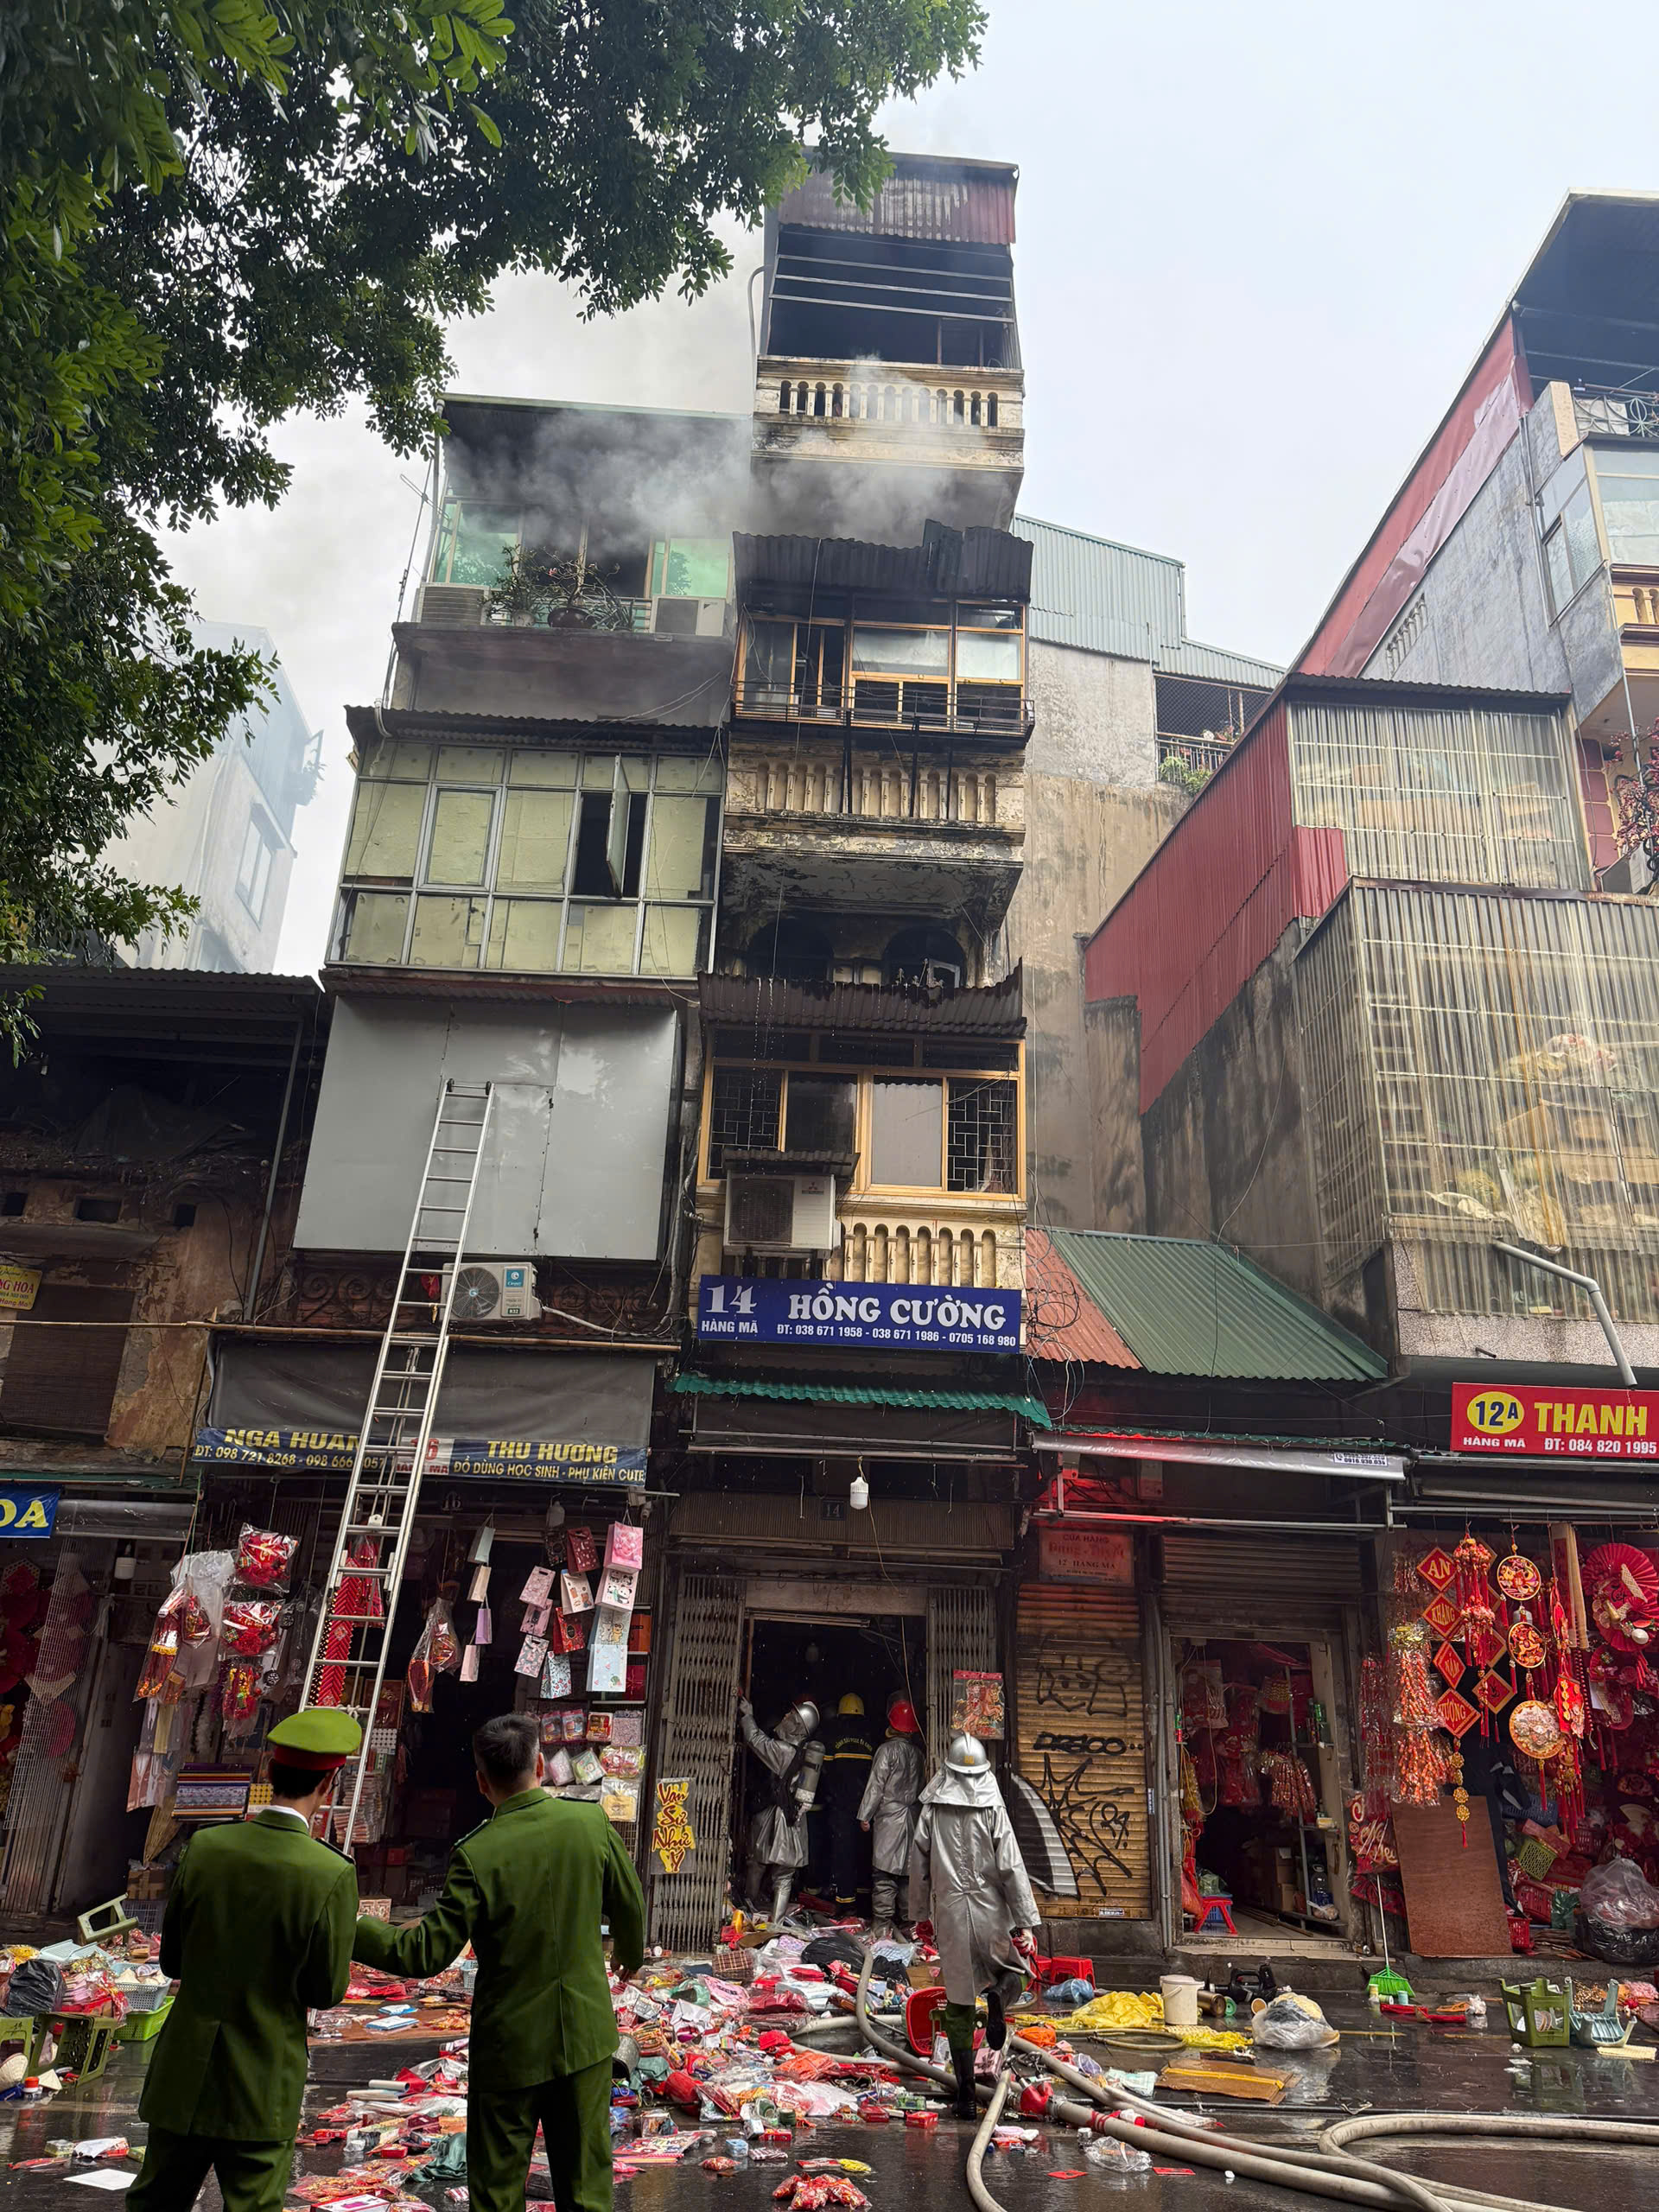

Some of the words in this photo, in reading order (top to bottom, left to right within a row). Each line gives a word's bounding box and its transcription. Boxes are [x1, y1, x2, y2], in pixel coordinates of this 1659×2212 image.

[13, 1281, 35, 1294] HOA
[705, 1285, 757, 1314] 14
[788, 1282, 881, 1323] HỒNG
[890, 1294, 1007, 1331] CƯỜNG
[702, 1319, 734, 1333] HÀNG
[739, 1320, 758, 1333] MÃ
[777, 1325, 792, 1335] ĐT:
[795, 1325, 814, 1336] 038
[817, 1325, 834, 1337] 671
[838, 1326, 862, 1338] 1958
[873, 1328, 891, 1339] 038
[893, 1330, 911, 1340] 671
[915, 1331, 939, 1342] 1986
[950, 1332, 974, 1344] 0705
[976, 1334, 995, 1345] 168
[997, 1336, 1016, 1347] 980
[1475, 1401, 1519, 1427] 12A
[1534, 1402, 1649, 1436] THANH
[224, 1428, 280, 1448] NGA
[1463, 1436, 1500, 1447] HÀNG
[1504, 1437, 1526, 1448] MÃ
[1544, 1438, 1565, 1451] ĐT:
[1569, 1439, 1592, 1452] 084
[1597, 1440, 1621, 1453] 820
[194, 1445, 213, 1458] ĐT:
[215, 1446, 238, 1459] 098
[241, 1449, 262, 1463] 721
[266, 1452, 296, 1465] 8268
[306, 1454, 327, 1466] 098
[332, 1456, 353, 1468] 666
[487, 1440, 531, 1459] THU
[537, 1443, 618, 1464] HƯƠNG
[454, 1455, 471, 1473] ĐỒ
[473, 1458, 505, 1474] DÙNG
[535, 1465, 559, 1478] SINH
[568, 1467, 589, 1483] PHỤ
[618, 1469, 645, 1482] CUTE
[1427, 1559, 1451, 1580] AN
[1431, 1603, 1456, 1626] KHANG
